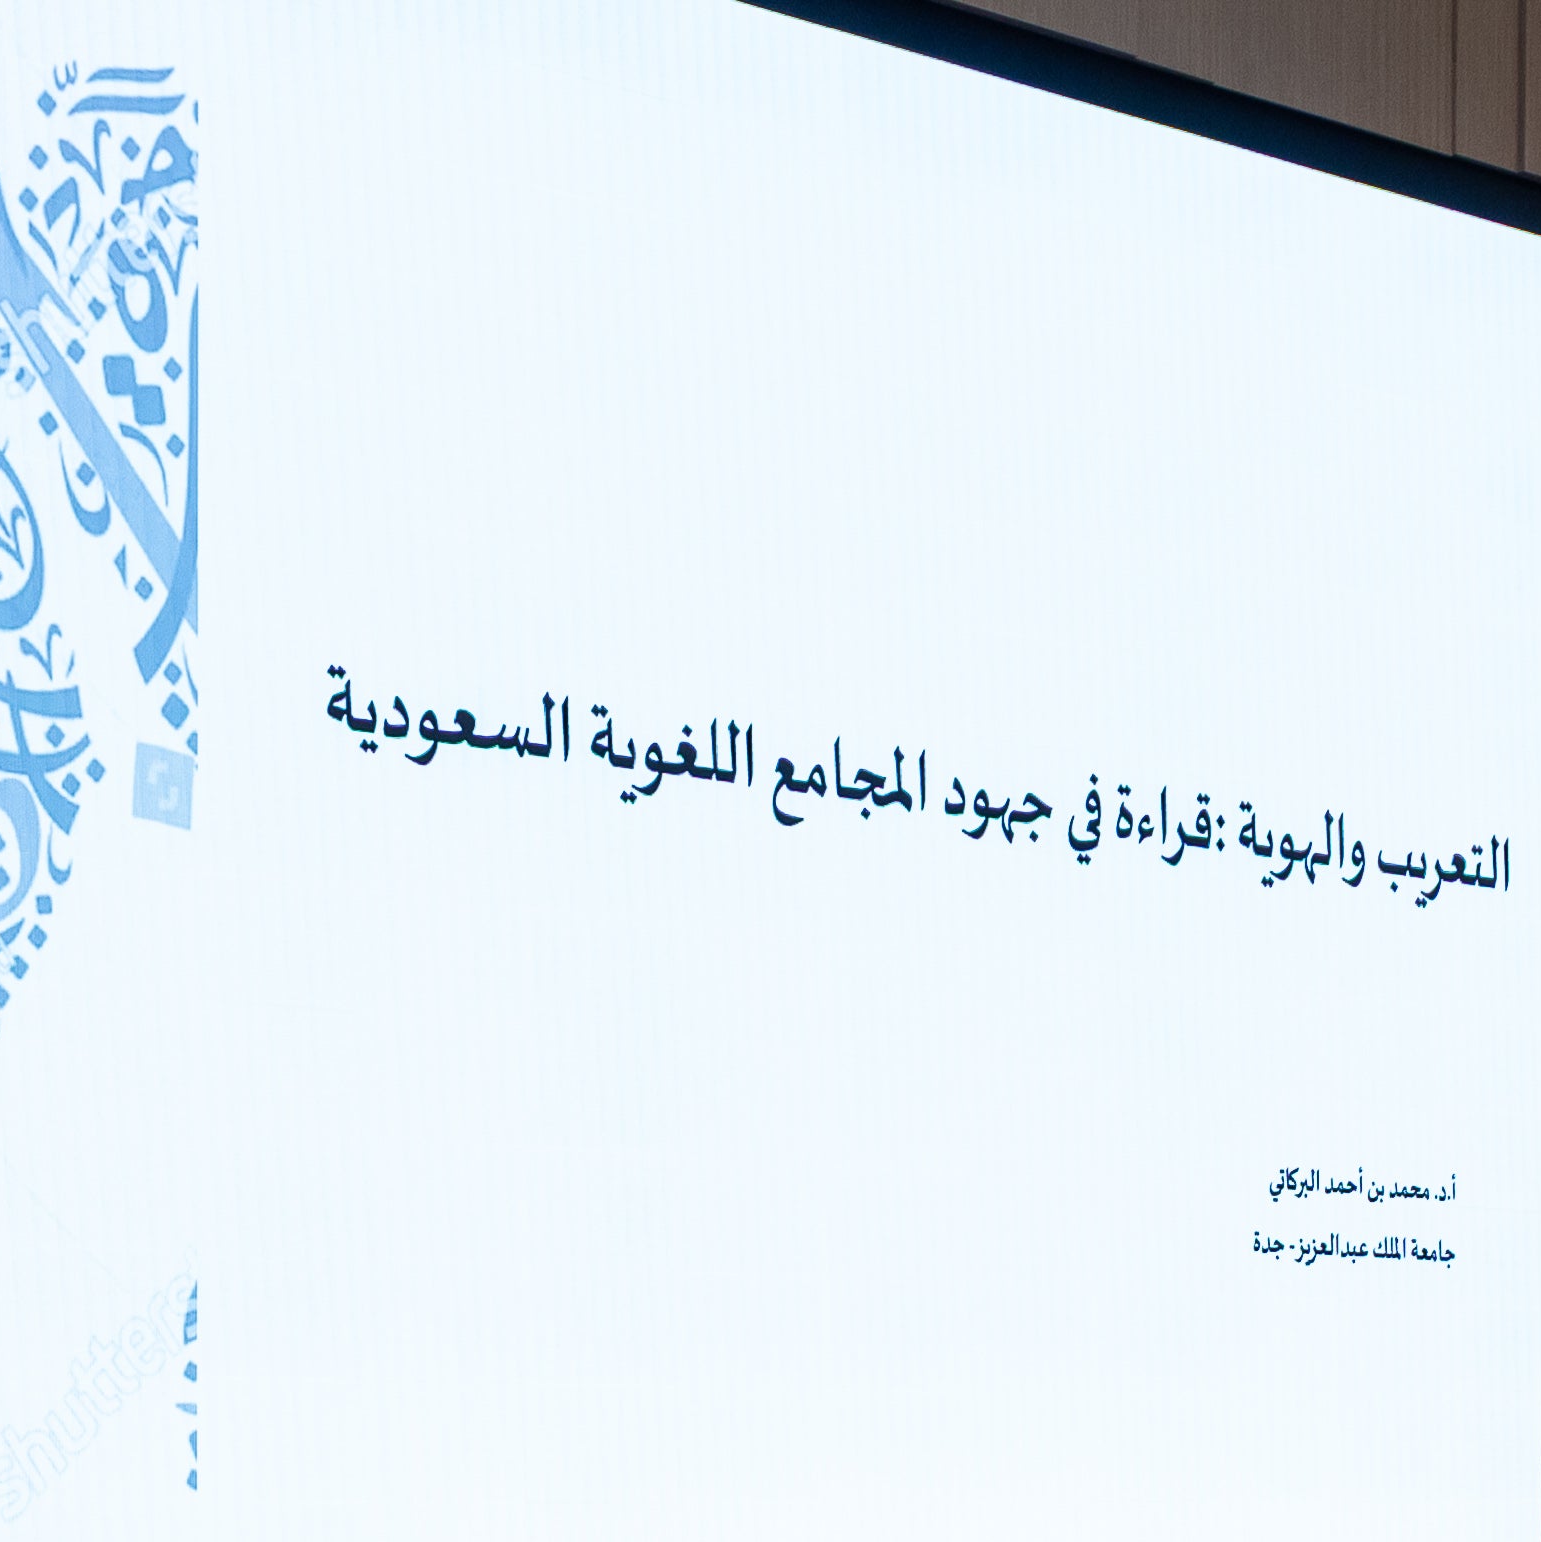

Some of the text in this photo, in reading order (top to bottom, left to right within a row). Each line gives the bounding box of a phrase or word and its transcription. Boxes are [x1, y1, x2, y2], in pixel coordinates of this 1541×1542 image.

[326, 664, 570, 766] السعودية
[590, 703, 754, 805] اللغوية
[772, 735, 926, 827] المجامع
[944, 776, 1053, 844] جهود
[1067, 773, 1102, 866] في
[1238, 800, 1366, 889] والهوية
[1377, 834, 1510, 909] التعريب
[1269, 1167, 1320, 1203] البركاتي
[1324, 1166, 1363, 1195] أحمد
[1367, 1181, 1385, 1204] بن
[1388, 1182, 1430, 1201] محمد
[1253, 1230, 1285, 1261] جدة
[1372, 1236, 1406, 1261] الملك
[1410, 1238, 1456, 1269] جامعة
